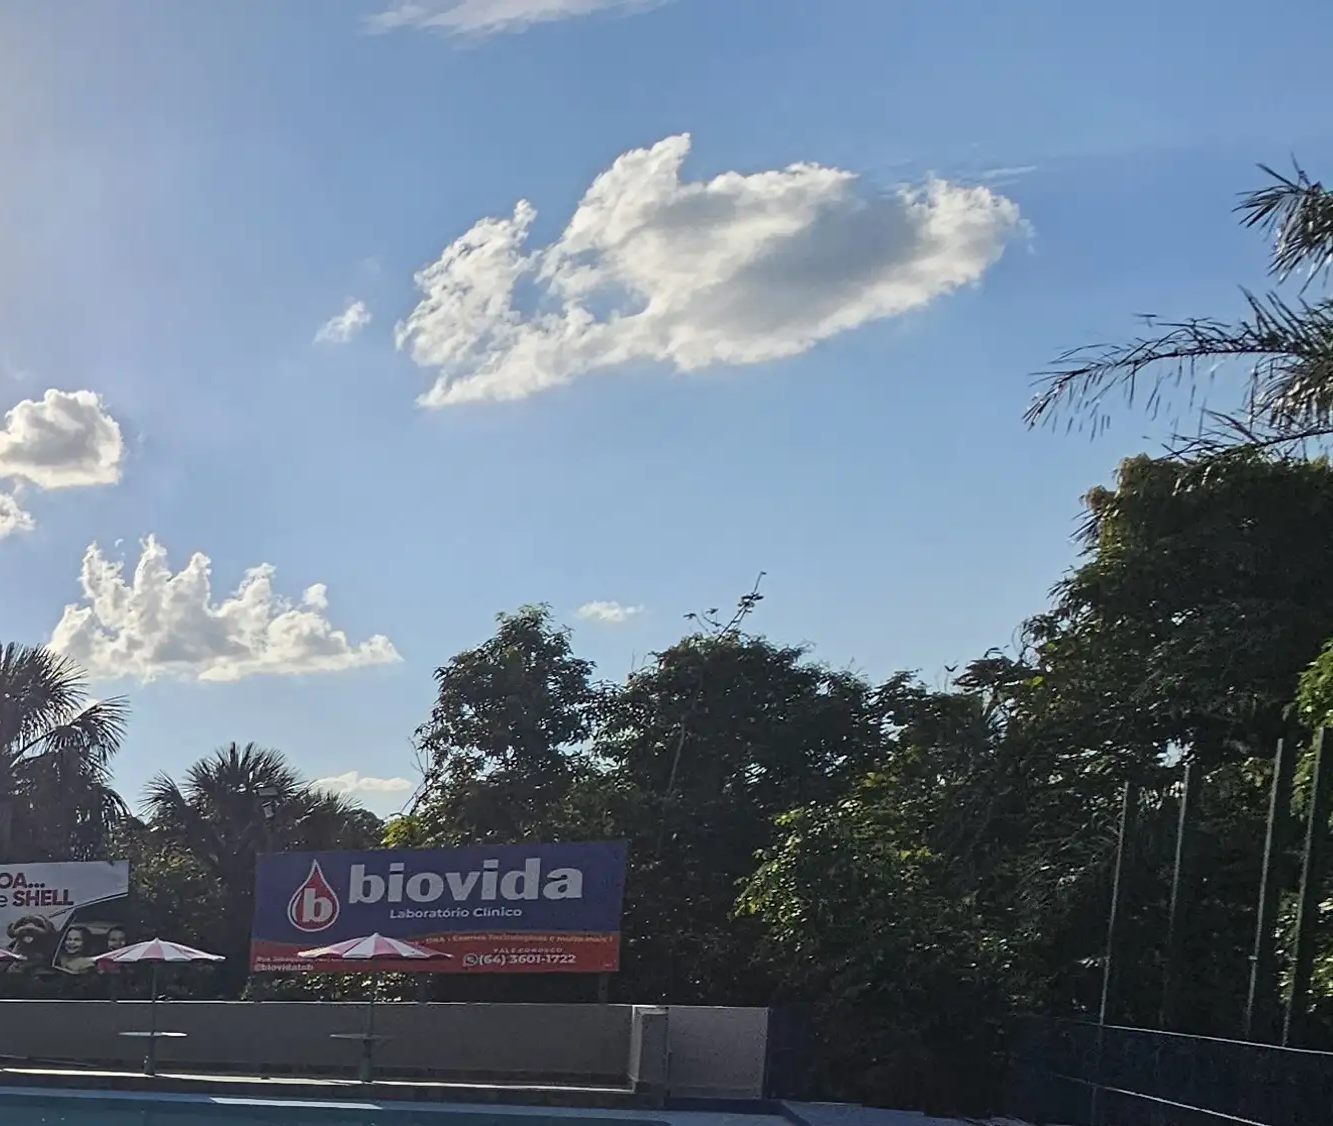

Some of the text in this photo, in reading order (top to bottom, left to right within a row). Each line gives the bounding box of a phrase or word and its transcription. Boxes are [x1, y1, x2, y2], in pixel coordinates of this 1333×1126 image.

[348, 858, 583, 904] biovida
[12, 889, 74, 907] SHELL
[389, 906, 523, 920] Laboratório Clínico
[479, 953, 577, 965] (64) 3601-1722
